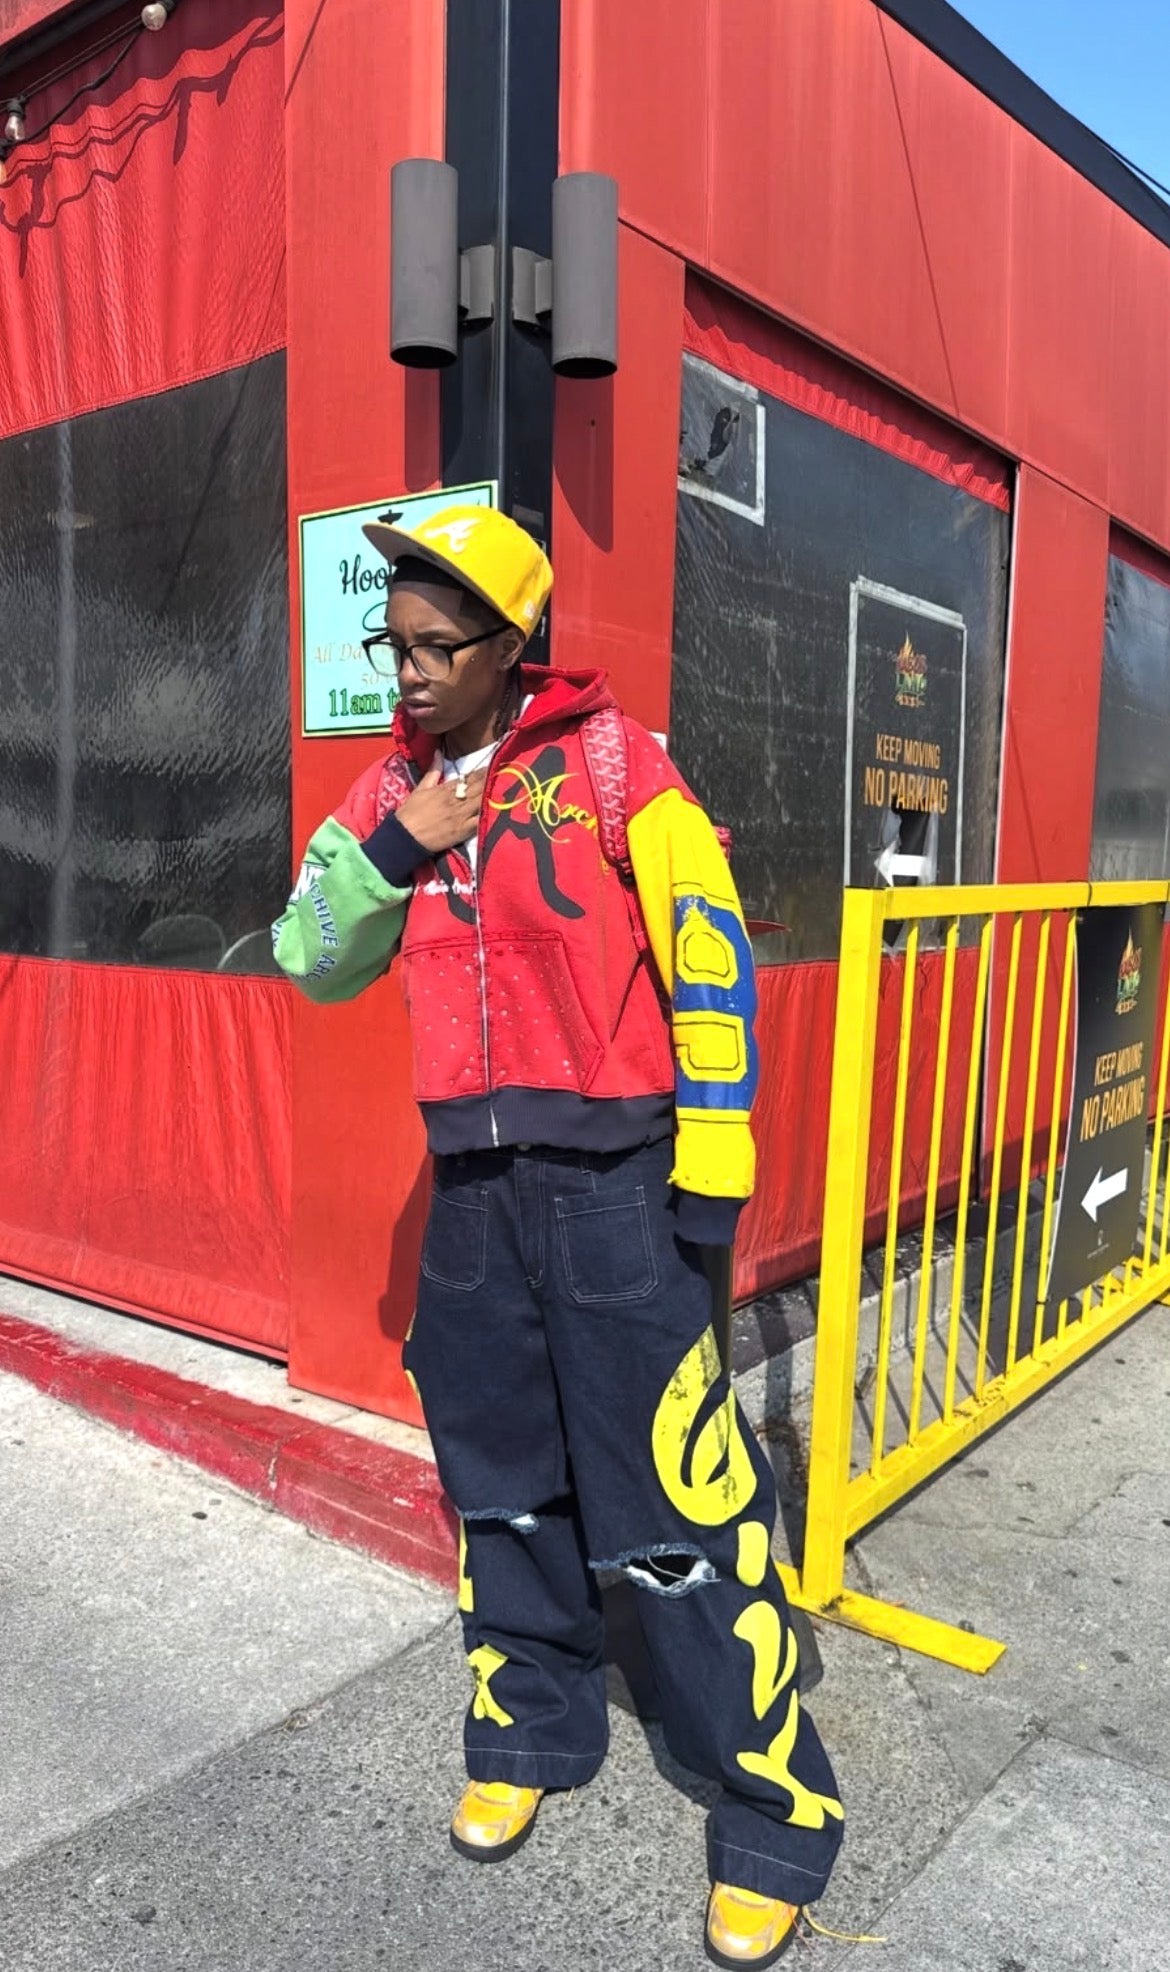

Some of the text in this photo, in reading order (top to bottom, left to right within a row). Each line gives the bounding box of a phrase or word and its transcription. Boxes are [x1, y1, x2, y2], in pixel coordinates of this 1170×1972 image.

[339, 554, 393, 595] Hoo
[339, 643, 363, 662] Da
[329, 688, 382, 717] 11am
[876, 733, 941, 770] KEEP MOVING
[864, 766, 948, 815] NO PARKING
[311, 883, 339, 947] CHIVE
[1094, 1041, 1143, 1087] KEEP MOVING
[1080, 1075, 1146, 1143] NO PARKING
